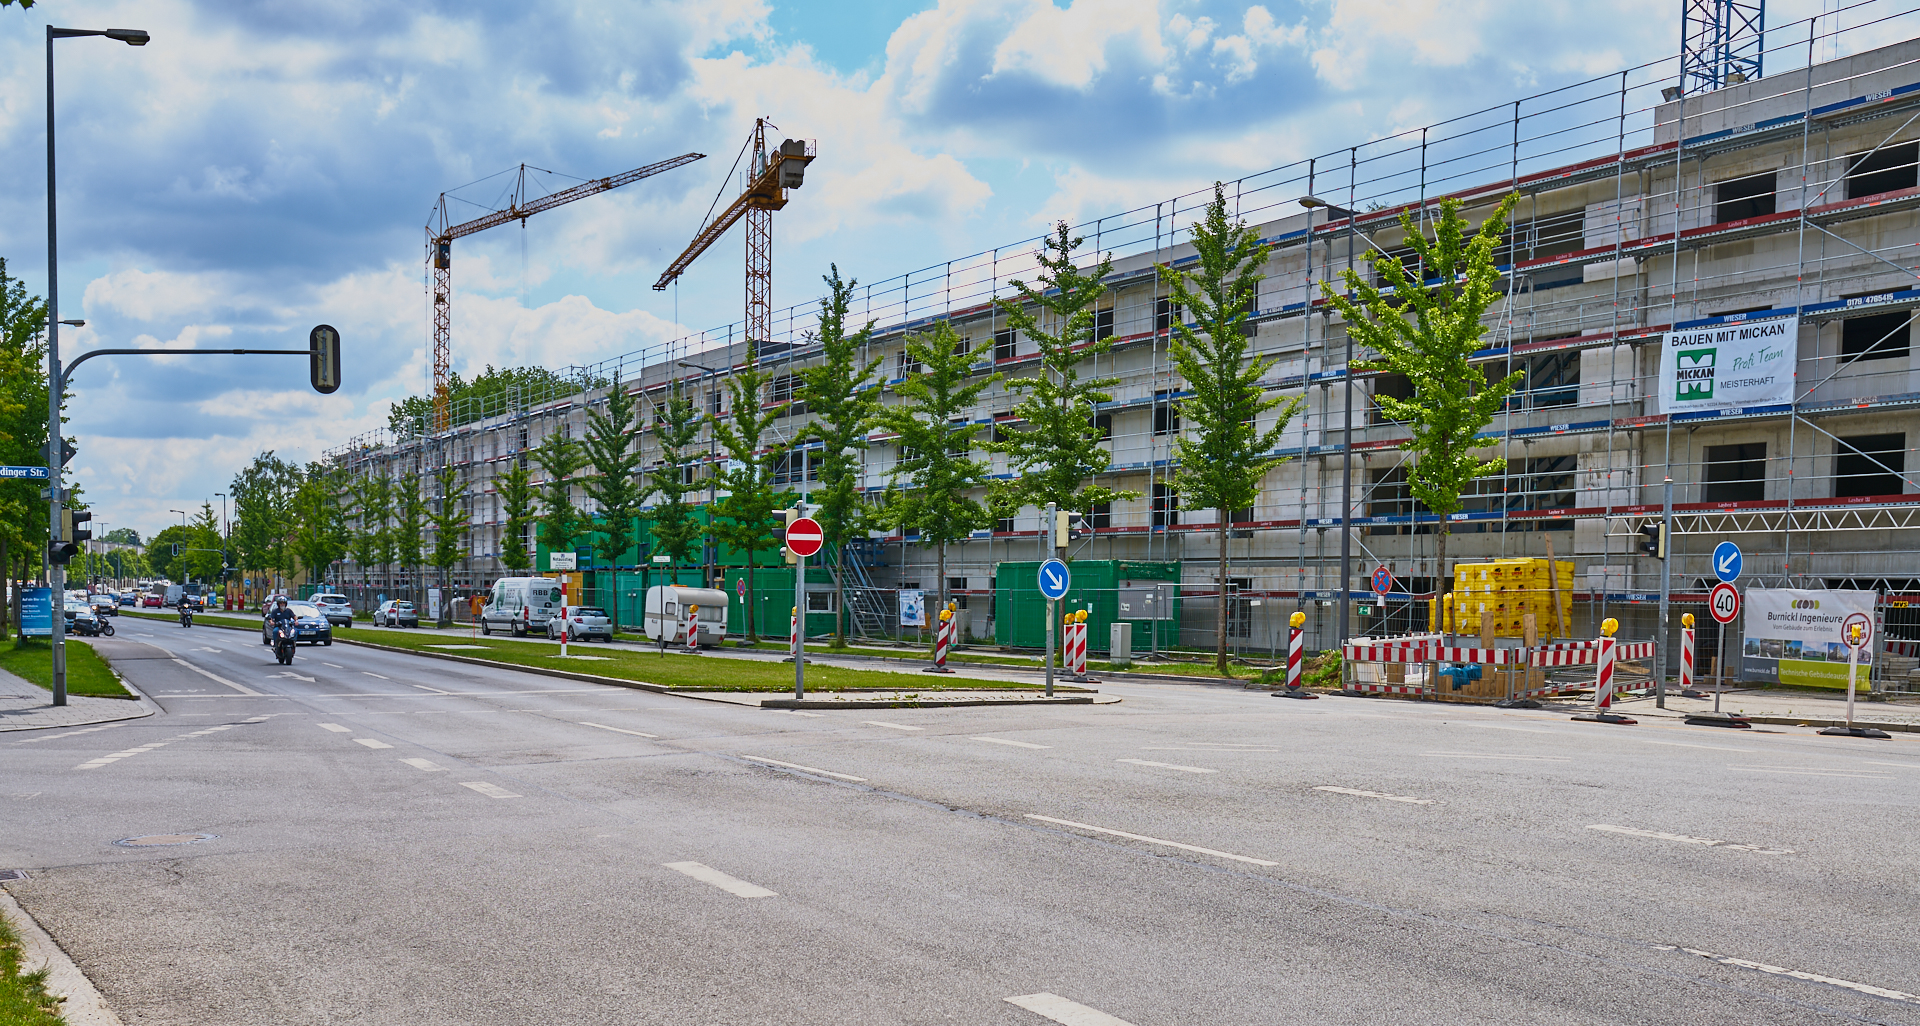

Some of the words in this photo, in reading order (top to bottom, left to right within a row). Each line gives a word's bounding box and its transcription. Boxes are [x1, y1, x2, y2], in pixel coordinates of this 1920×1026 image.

[1865, 89, 1892, 102] WIESER
[1732, 123, 1756, 134] WIESER
[1723, 313, 1747, 322] WIESER
[1671, 333, 1713, 346] BAUEN
[1716, 330, 1736, 342] MIT
[1739, 323, 1785, 340] MICKAN
[1733, 352, 1755, 371] Profi
[1758, 345, 1783, 363] Team
[1676, 367, 1715, 380] MICKAN
[1720, 376, 1775, 389] MEISTERHAFT
[1720, 408, 1743, 416] WIESER
[1550, 423, 1570, 431] WIESER
[0, 467, 27, 477] dinger
[30, 468, 45, 477] Str.
[1451, 513, 1469, 521] WIESER
[1715, 593, 1734, 613] 40
[1767, 611, 1798, 622] Burnickl
[1799, 613, 1843, 625] Ingenieure
[1780, 668, 1807, 677] Technische
